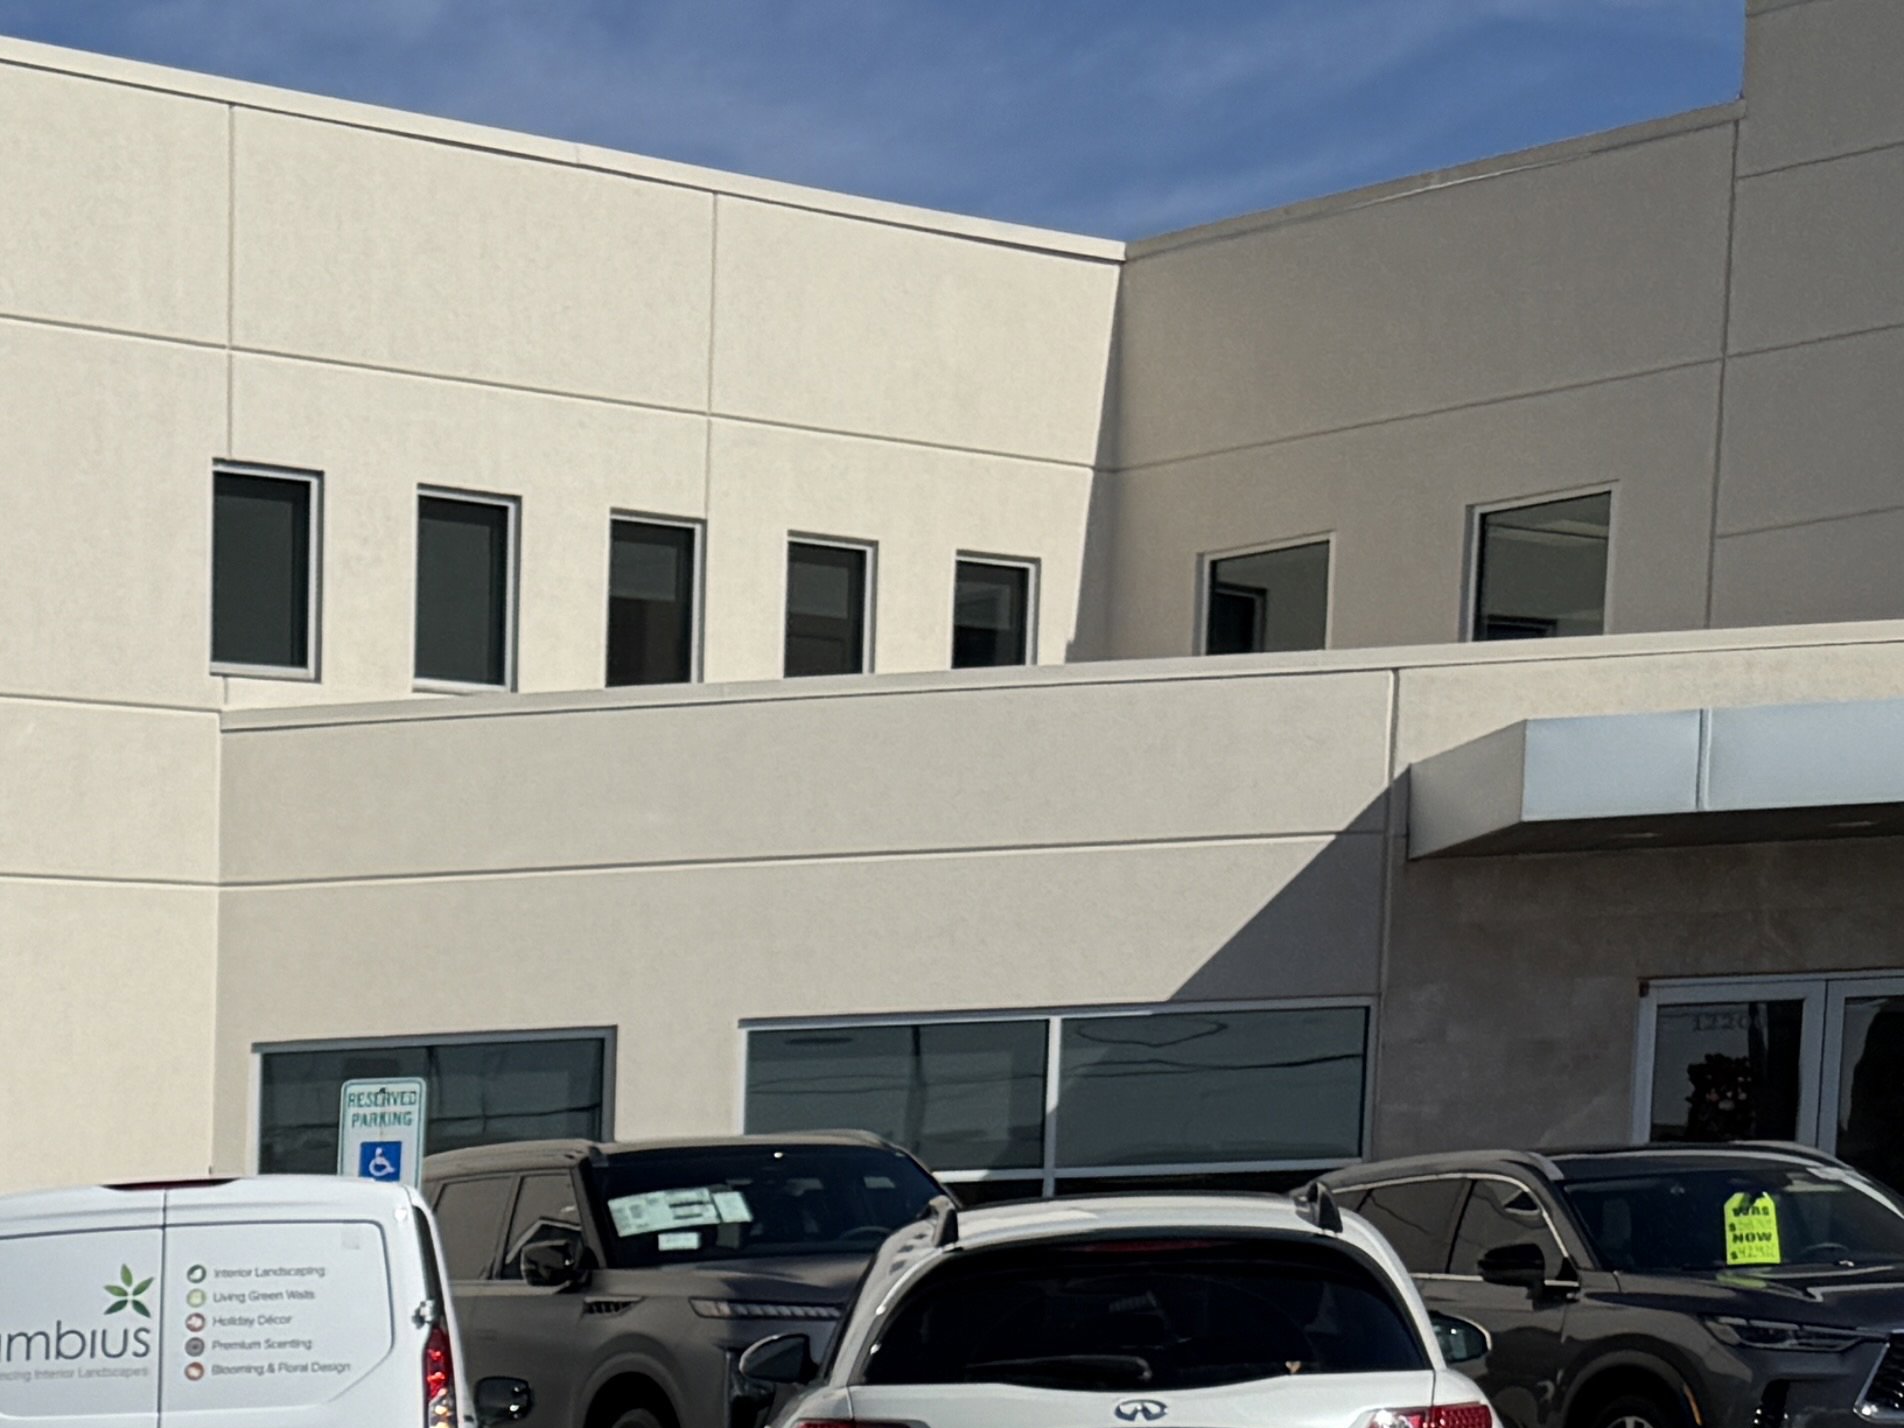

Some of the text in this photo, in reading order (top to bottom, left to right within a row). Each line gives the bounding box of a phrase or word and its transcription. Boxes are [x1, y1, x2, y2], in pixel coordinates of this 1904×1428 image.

[347, 1091, 417, 1109] RESERVED
[352, 1111, 413, 1128] PARKING
[1732, 1232, 1772, 1244] NOW
